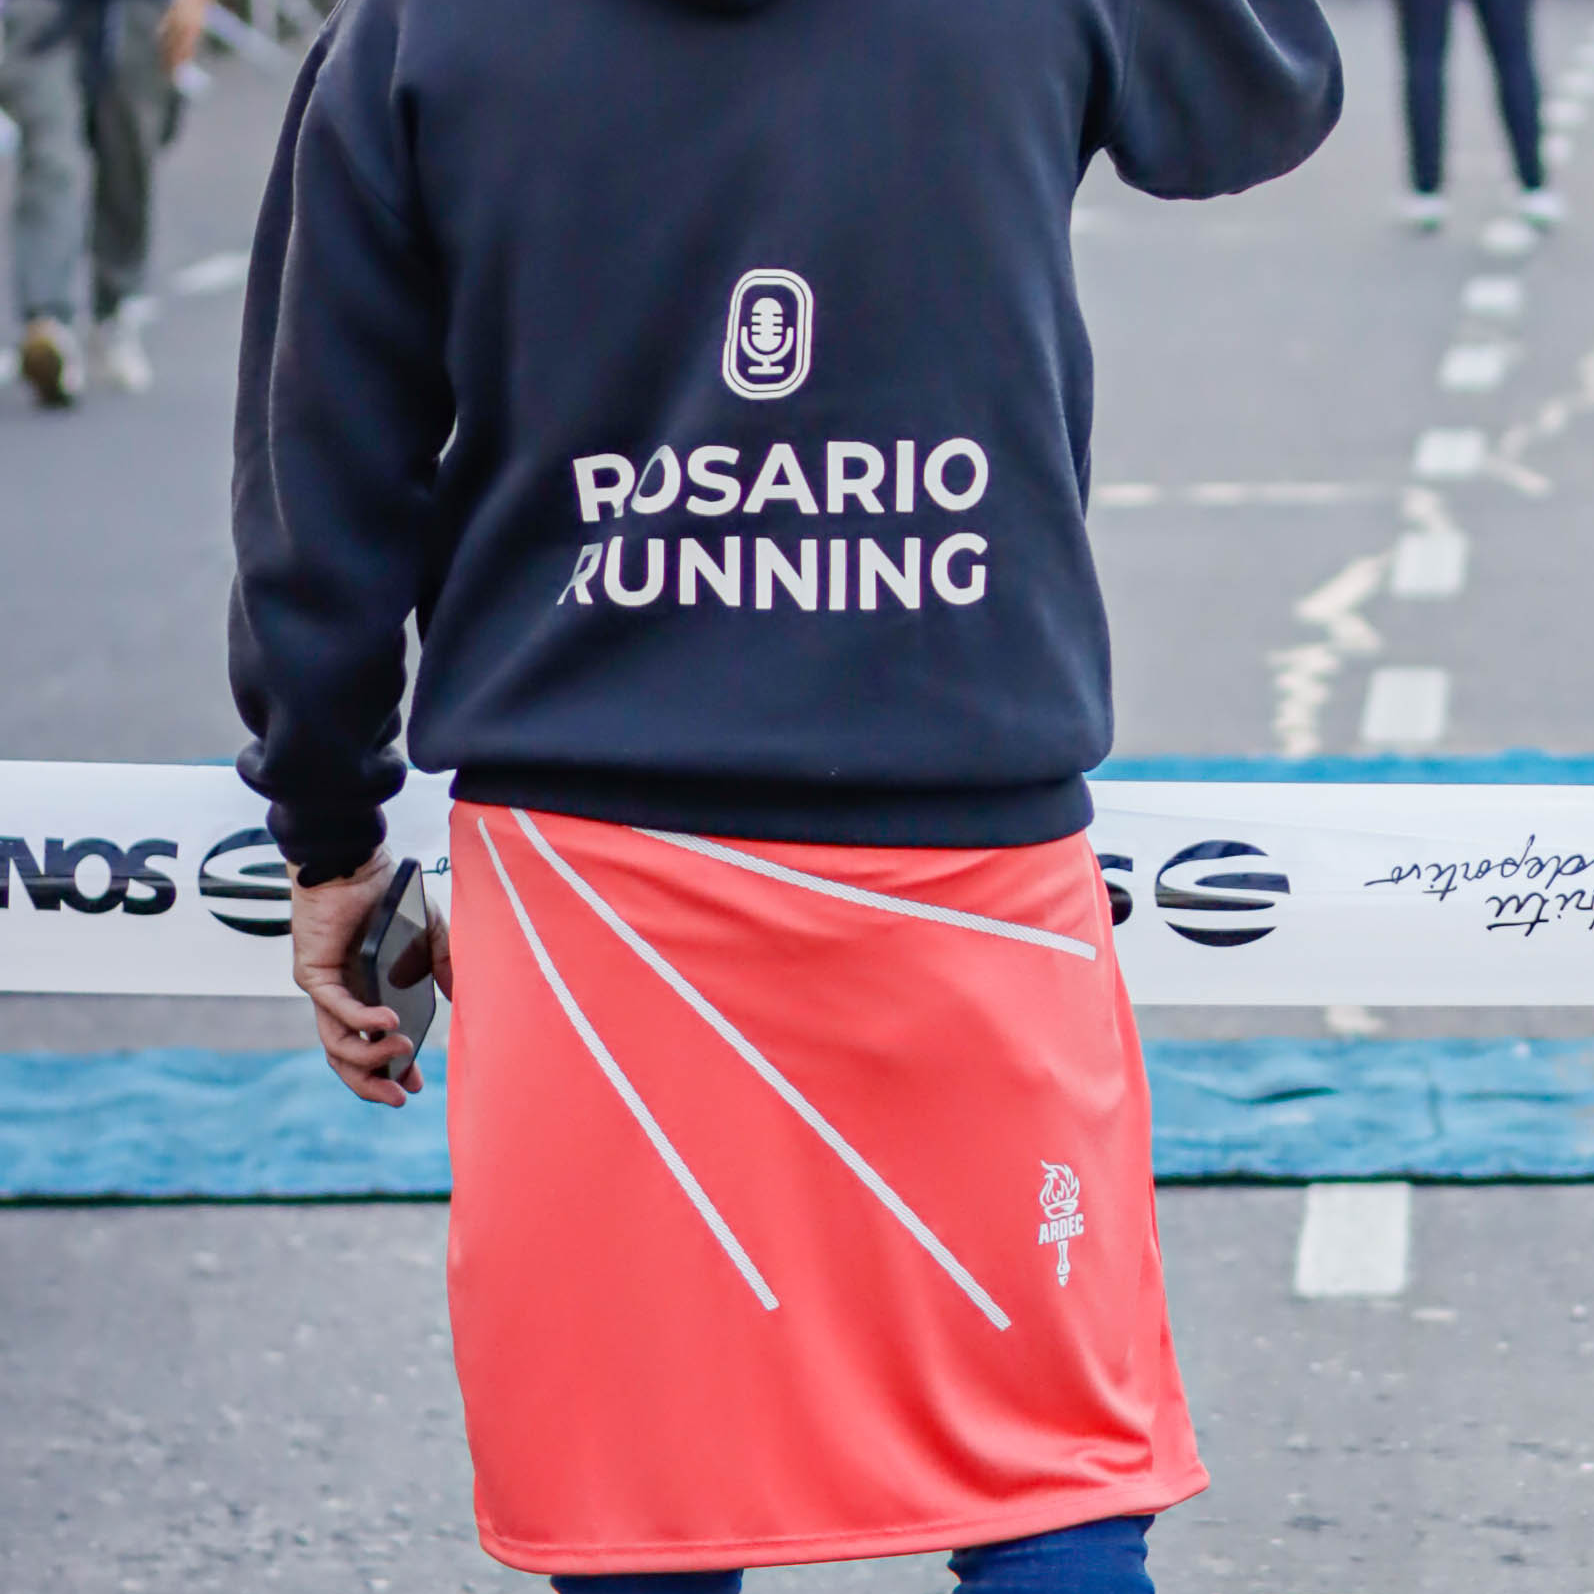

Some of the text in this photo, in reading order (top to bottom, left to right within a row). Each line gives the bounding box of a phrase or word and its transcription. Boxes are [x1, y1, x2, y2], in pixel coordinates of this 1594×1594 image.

[573, 438, 989, 522] ROSARIO
[557, 533, 988, 611] RUNNING
[0, 837, 178, 915] SON
[1038, 1213, 1085, 1246] ARDEC
